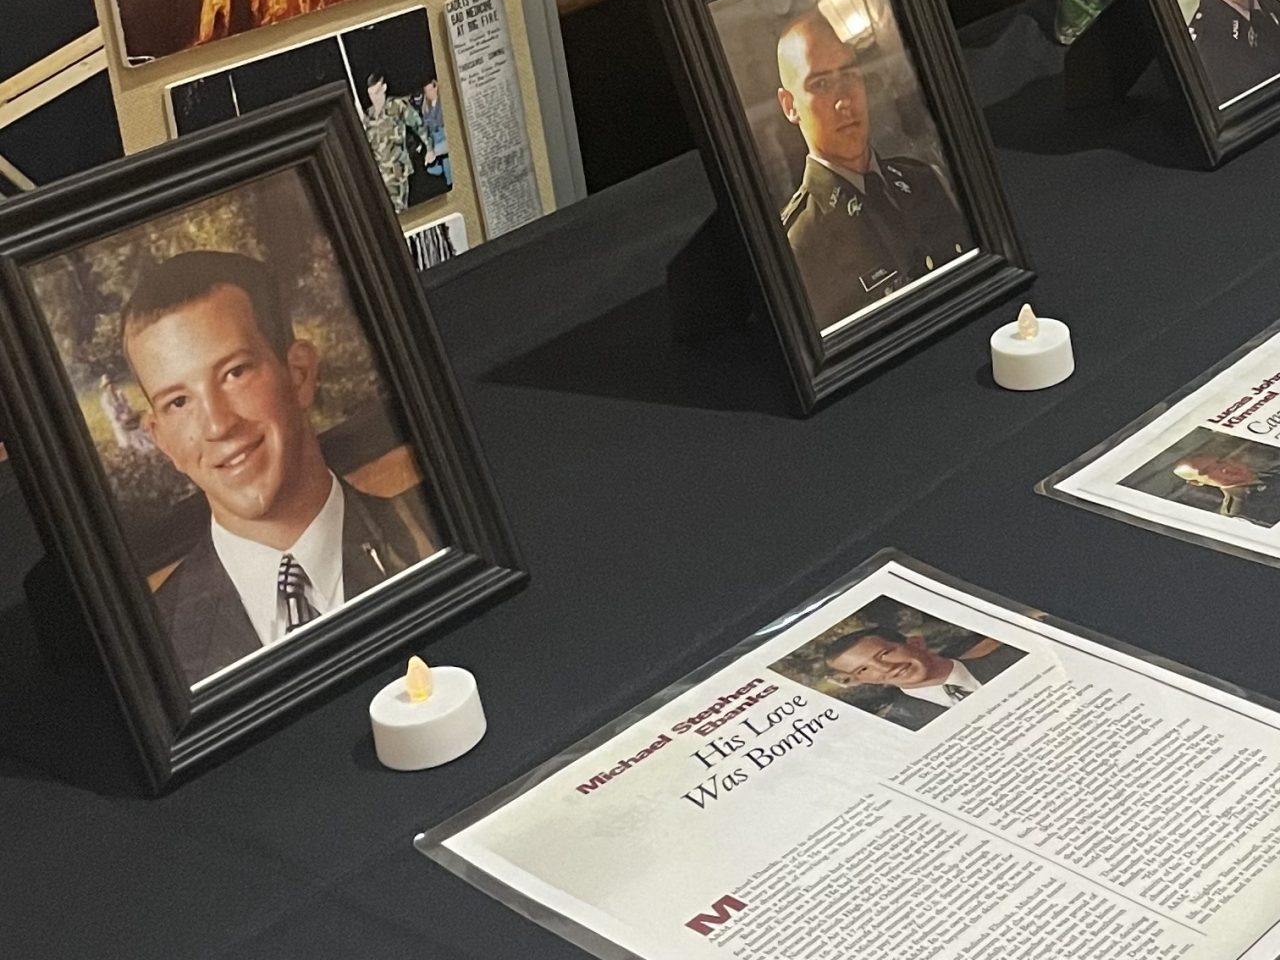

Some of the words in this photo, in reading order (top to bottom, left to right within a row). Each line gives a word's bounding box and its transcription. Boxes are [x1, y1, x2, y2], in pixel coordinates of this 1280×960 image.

[446, 0, 470, 14] CADETS
[451, 11, 464, 26] BAD
[466, 0, 493, 19] MEDICINE
[457, 24, 464, 37] AT
[481, 10, 498, 27] FIRE
[1207, 396, 1253, 424] Lucas
[1222, 391, 1279, 428] Kimmel
[695, 685, 779, 736] Ebanks
[576, 734, 672, 794] Michael
[672, 678, 764, 734] Stephen
[691, 735, 745, 768] His
[739, 696, 807, 737] Love
[681, 768, 748, 809] Was
[744, 709, 839, 770] Bonfire
[685, 895, 748, 936] M
